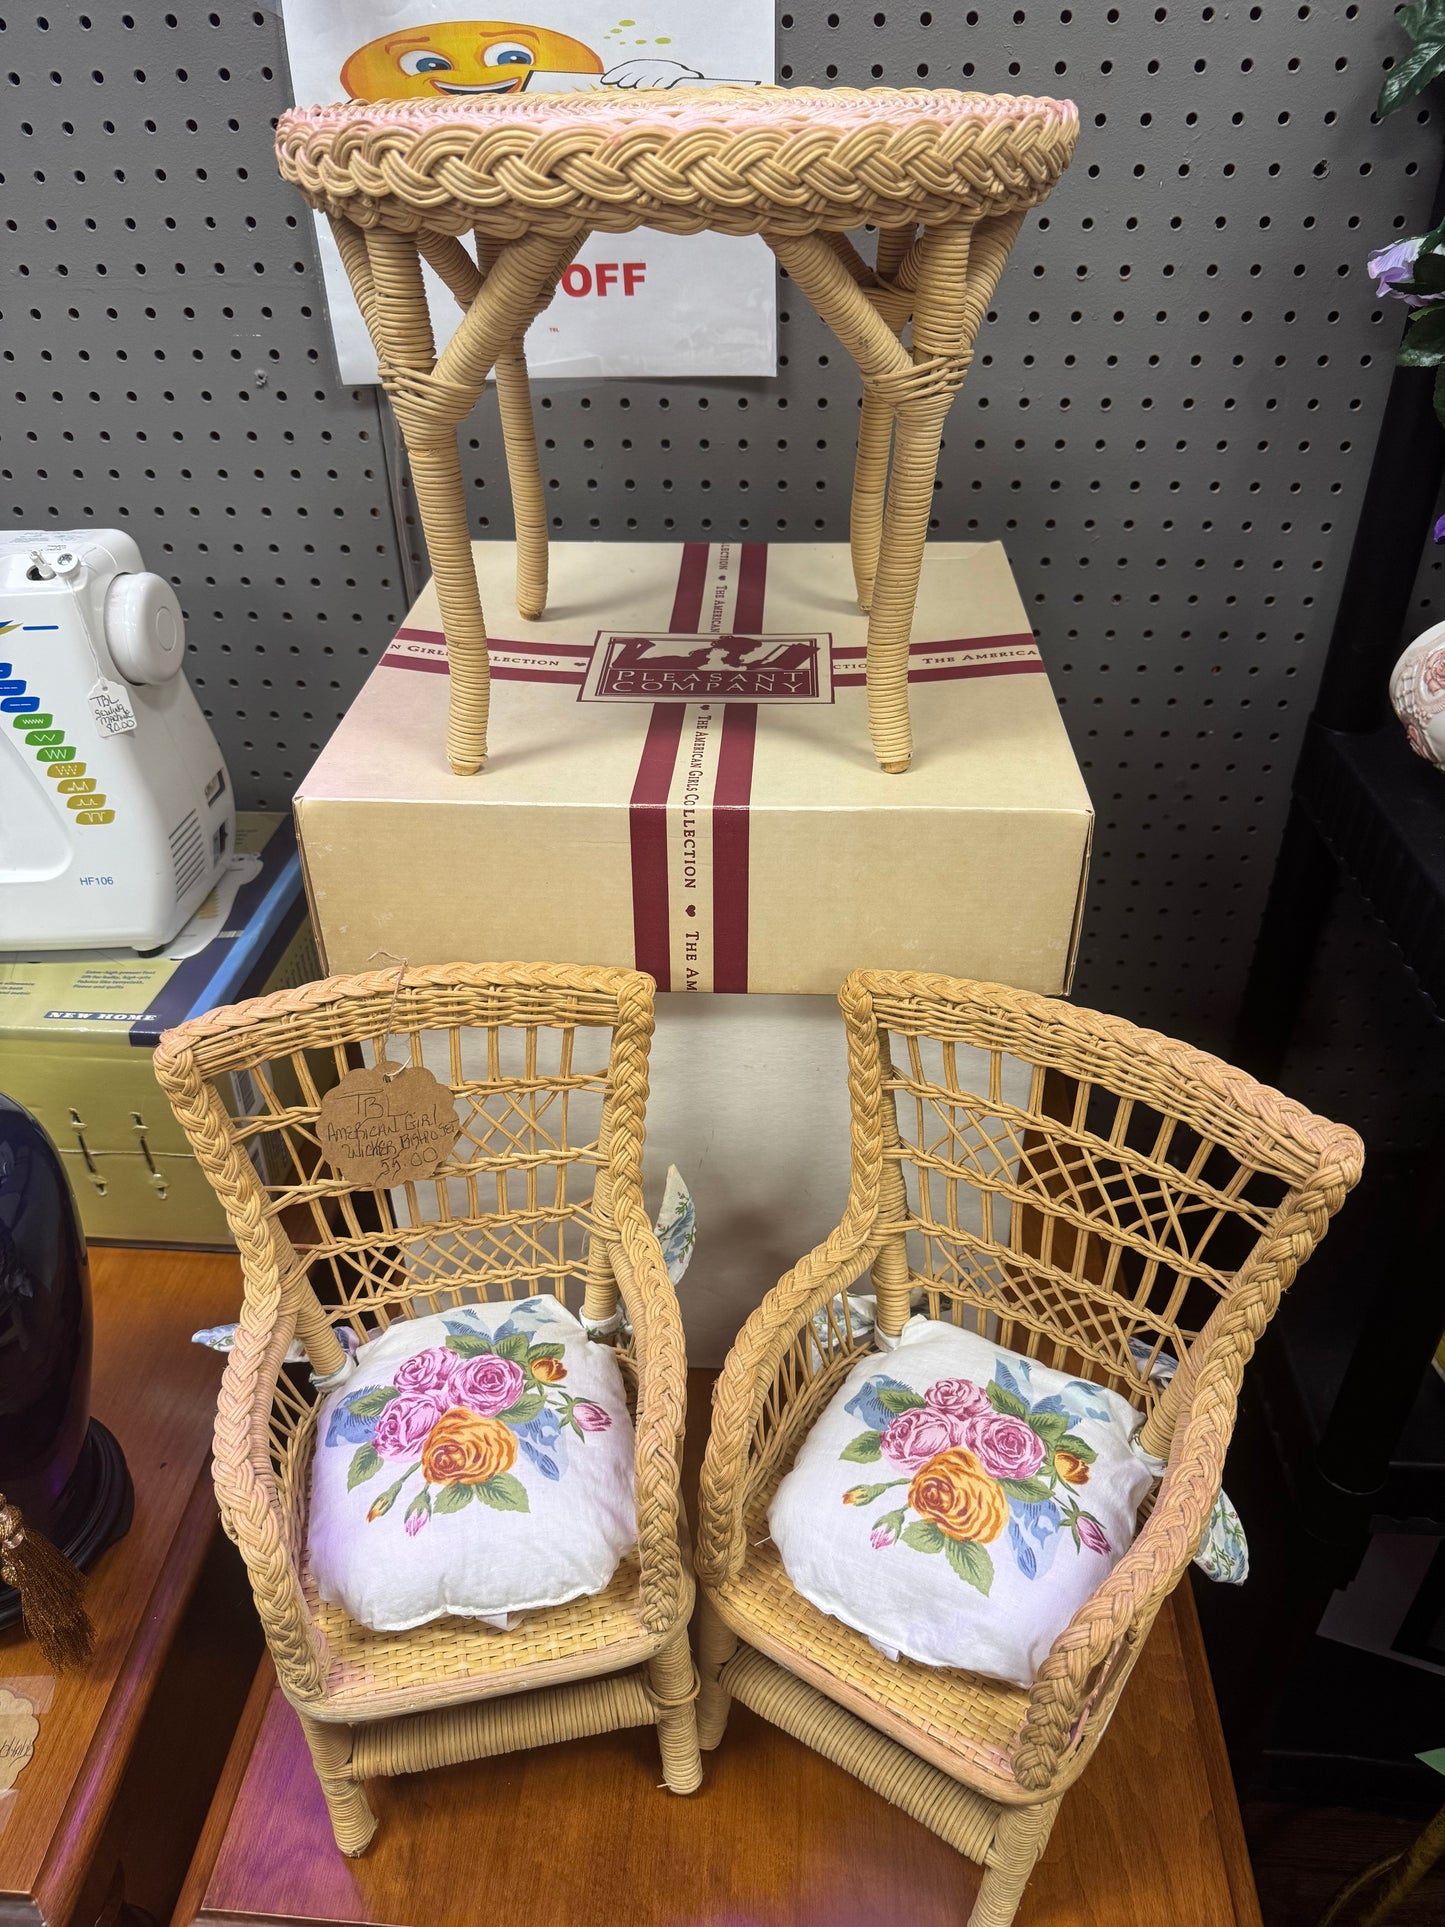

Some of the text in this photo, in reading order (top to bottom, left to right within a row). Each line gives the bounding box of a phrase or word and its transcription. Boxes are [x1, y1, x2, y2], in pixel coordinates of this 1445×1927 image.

[561, 262, 646, 298] OFF
[710, 543, 730, 633] LECTION THE AMERICAN
[407, 645, 449, 656] GIRL
[489, 656, 560, 666] LECTION
[922, 657, 955, 665] THE
[961, 650, 1038, 662] AMERICA
[617, 670, 804, 683] PLEASANT
[612, 681, 804, 693] COMPANY
[89, 694, 120, 707] TBL
[683, 715, 712, 889] THE AMERICAN GIRLS COLLECTION
[79, 876, 114, 886] HF106
[685, 931, 699, 961] THE
[97, 1013, 157, 1021] HOME
[336, 1088, 409, 1120] TBL
